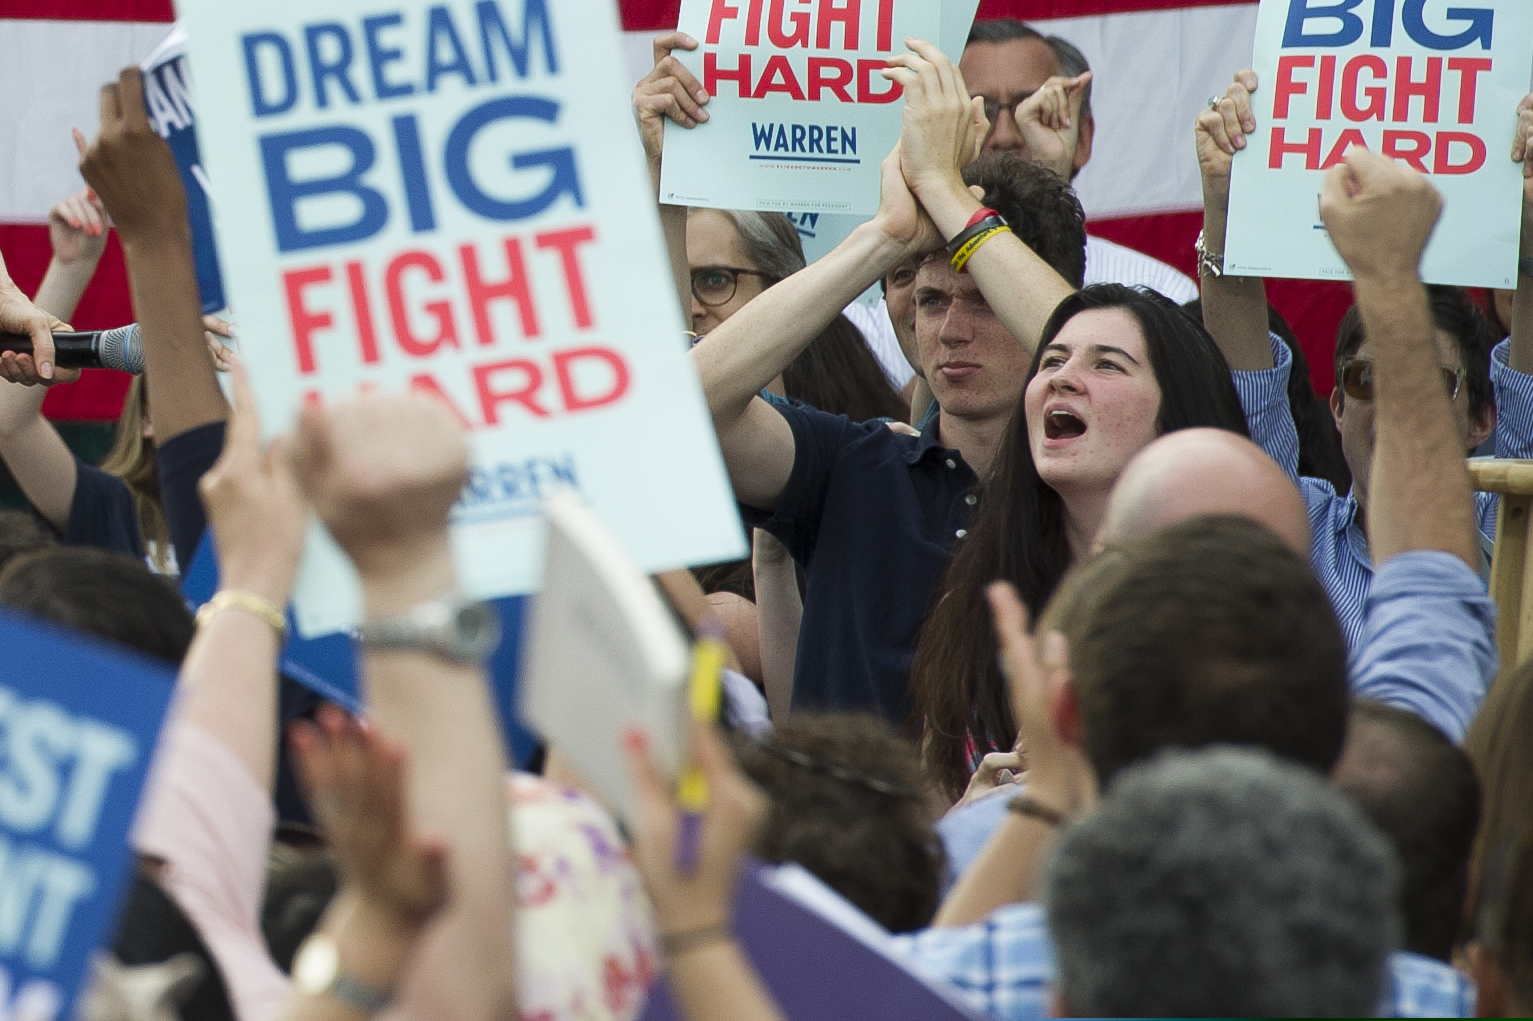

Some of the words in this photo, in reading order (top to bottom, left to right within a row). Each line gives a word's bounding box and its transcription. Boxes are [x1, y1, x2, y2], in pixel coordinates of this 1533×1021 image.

[703, 54, 905, 104] HARD
[1273, 55, 1492, 124] FIGHT
[751, 122, 857, 156] WARREN
[1268, 128, 1487, 175] HARD
[256, 95, 586, 256] BIG
[282, 226, 601, 375] FIGHT
